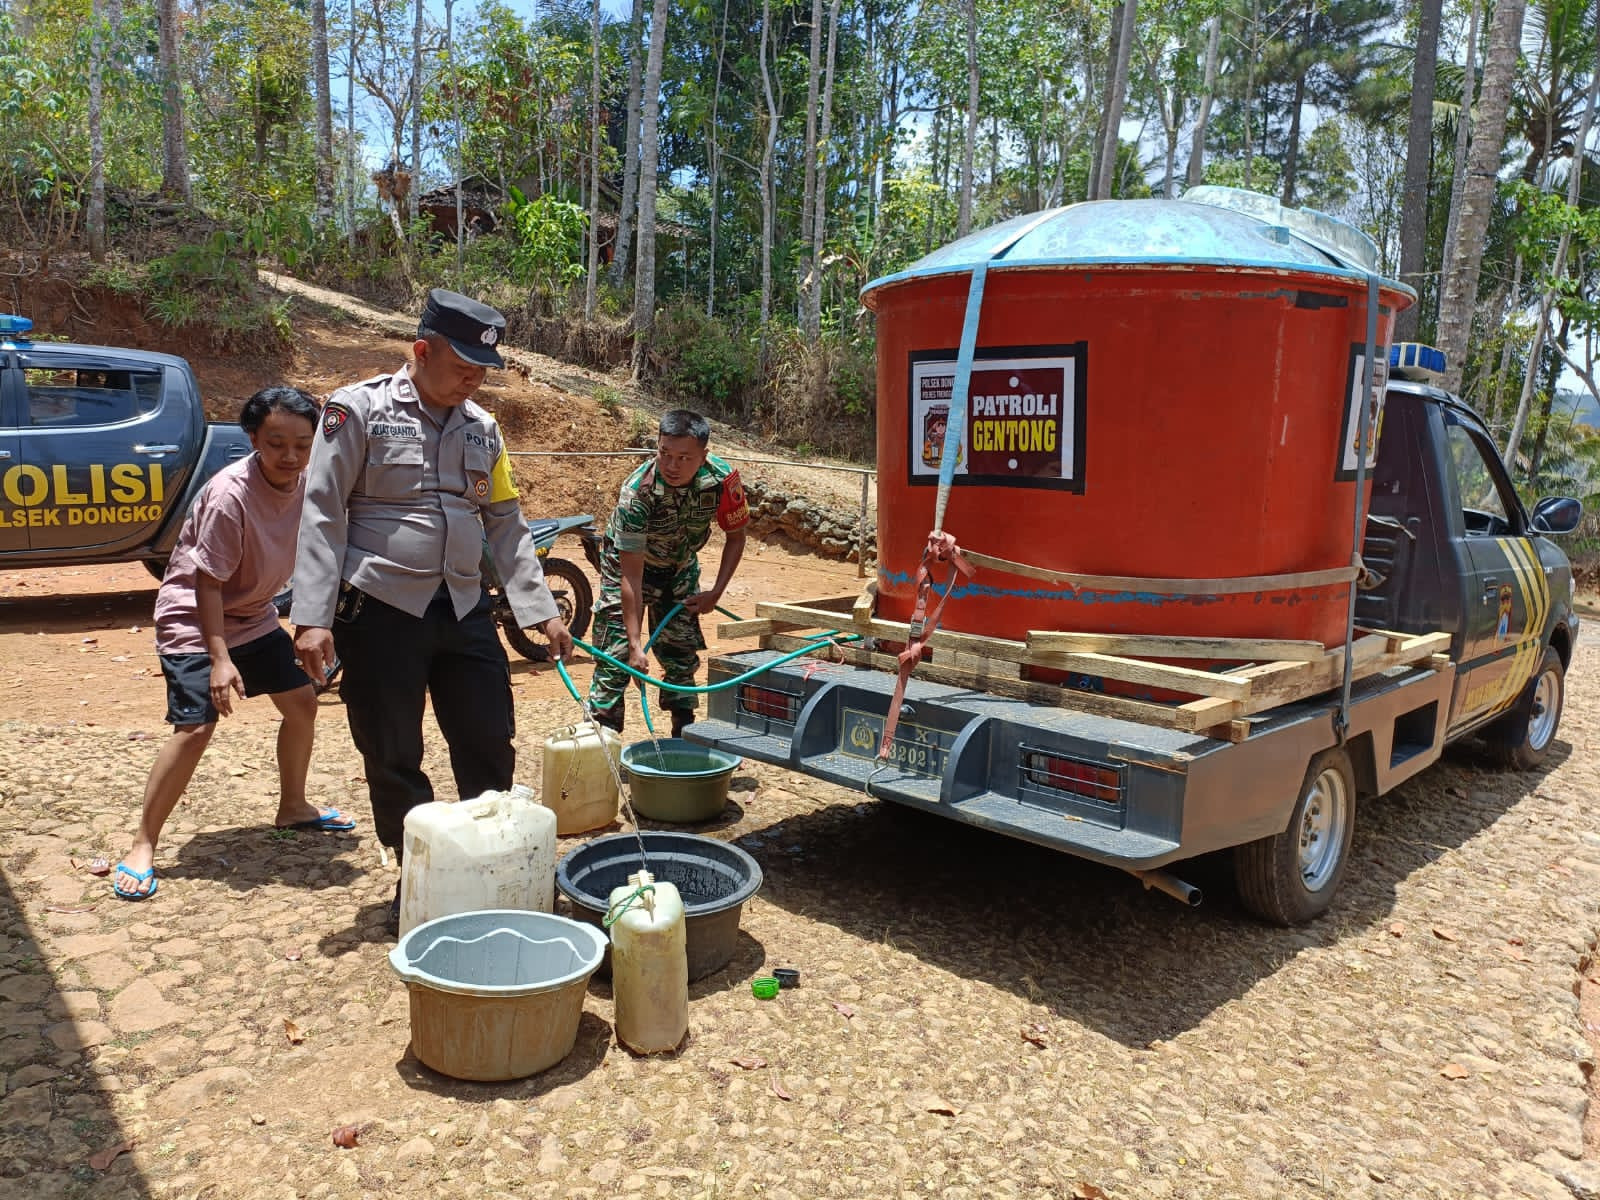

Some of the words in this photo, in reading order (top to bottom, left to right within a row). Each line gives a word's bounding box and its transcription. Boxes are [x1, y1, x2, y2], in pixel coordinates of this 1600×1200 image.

[973, 394, 1057, 416] PATROLI
[973, 420, 1057, 451] GENTONG
[68, 505, 163, 525] DONGKO
